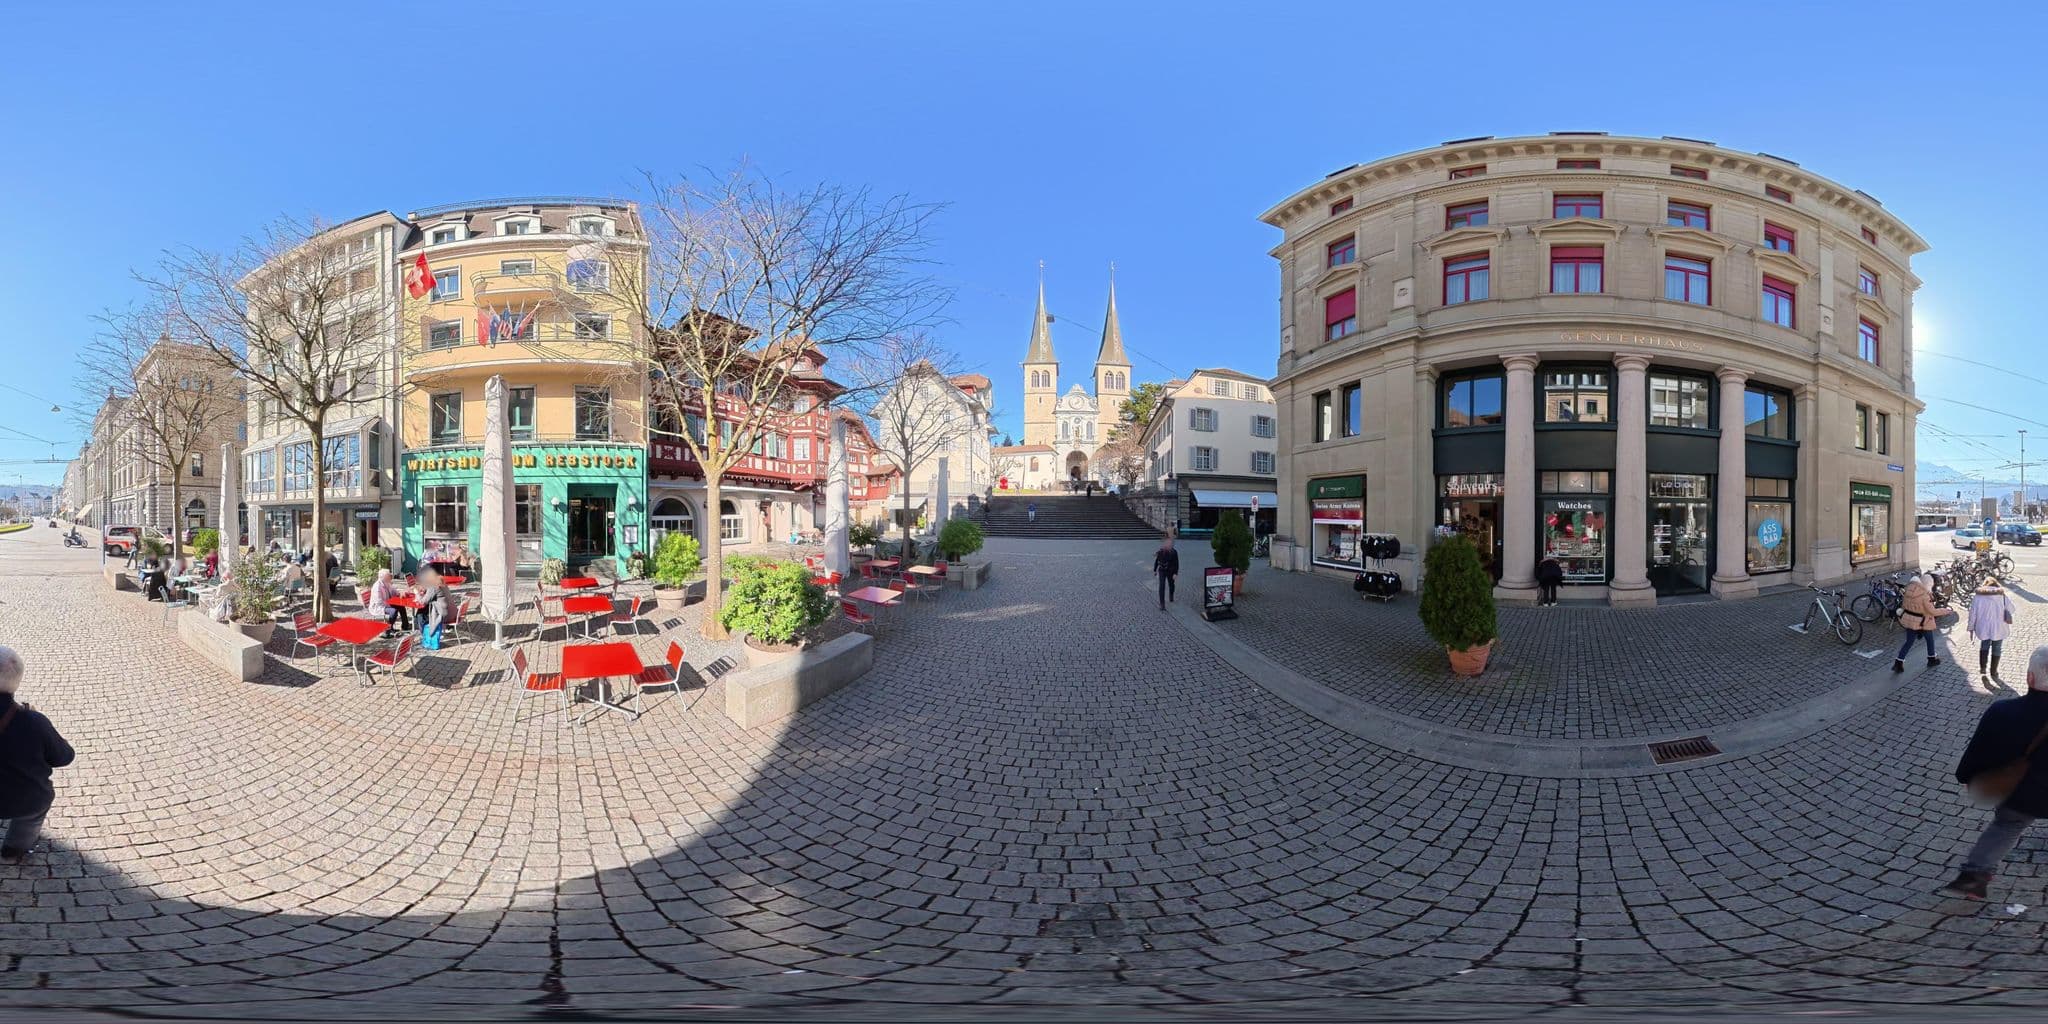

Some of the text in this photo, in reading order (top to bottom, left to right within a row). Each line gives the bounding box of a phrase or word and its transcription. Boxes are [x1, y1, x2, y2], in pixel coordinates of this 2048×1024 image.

[1560, 332, 1705, 350] GENFERHAUS
[407, 454, 637, 473] WIRTSHU UM REBSTOCK
[1557, 501, 1592, 510] Watches
[1762, 523, 1777, 535] ASS
[1763, 533, 1778, 545] BAR
